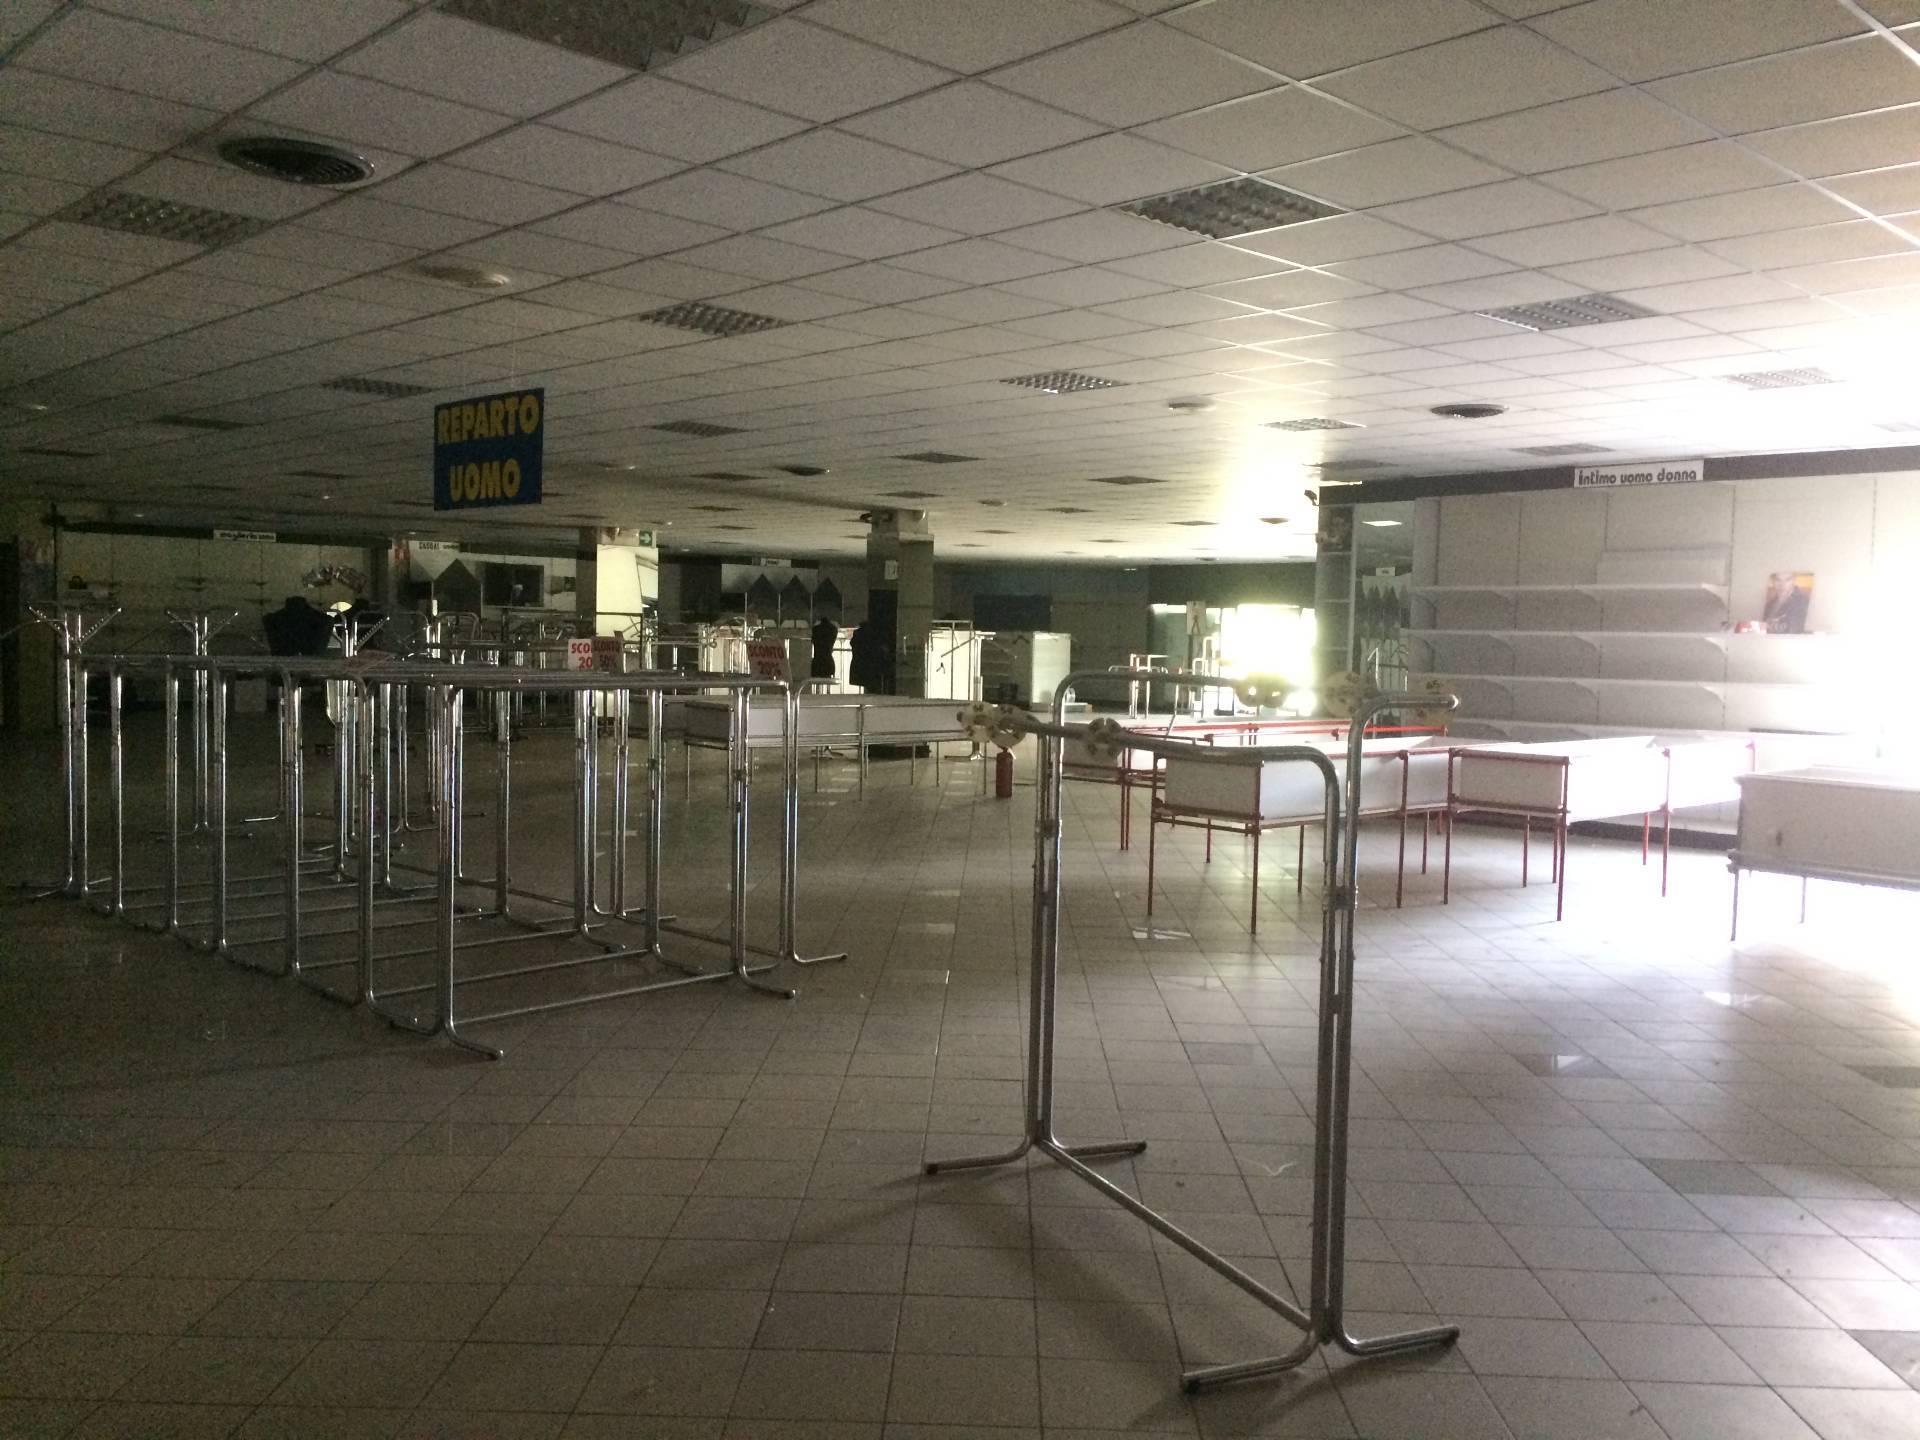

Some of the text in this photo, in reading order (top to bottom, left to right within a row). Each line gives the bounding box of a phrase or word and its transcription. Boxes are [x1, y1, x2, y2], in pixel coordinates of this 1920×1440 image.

[438, 394, 540, 445] REPARTO
[448, 458, 521, 502] UOMO
[1578, 467, 1697, 486] intimo uomo donna
[571, 642, 593, 654] SCO
[748, 643, 785, 659] SCONTO
